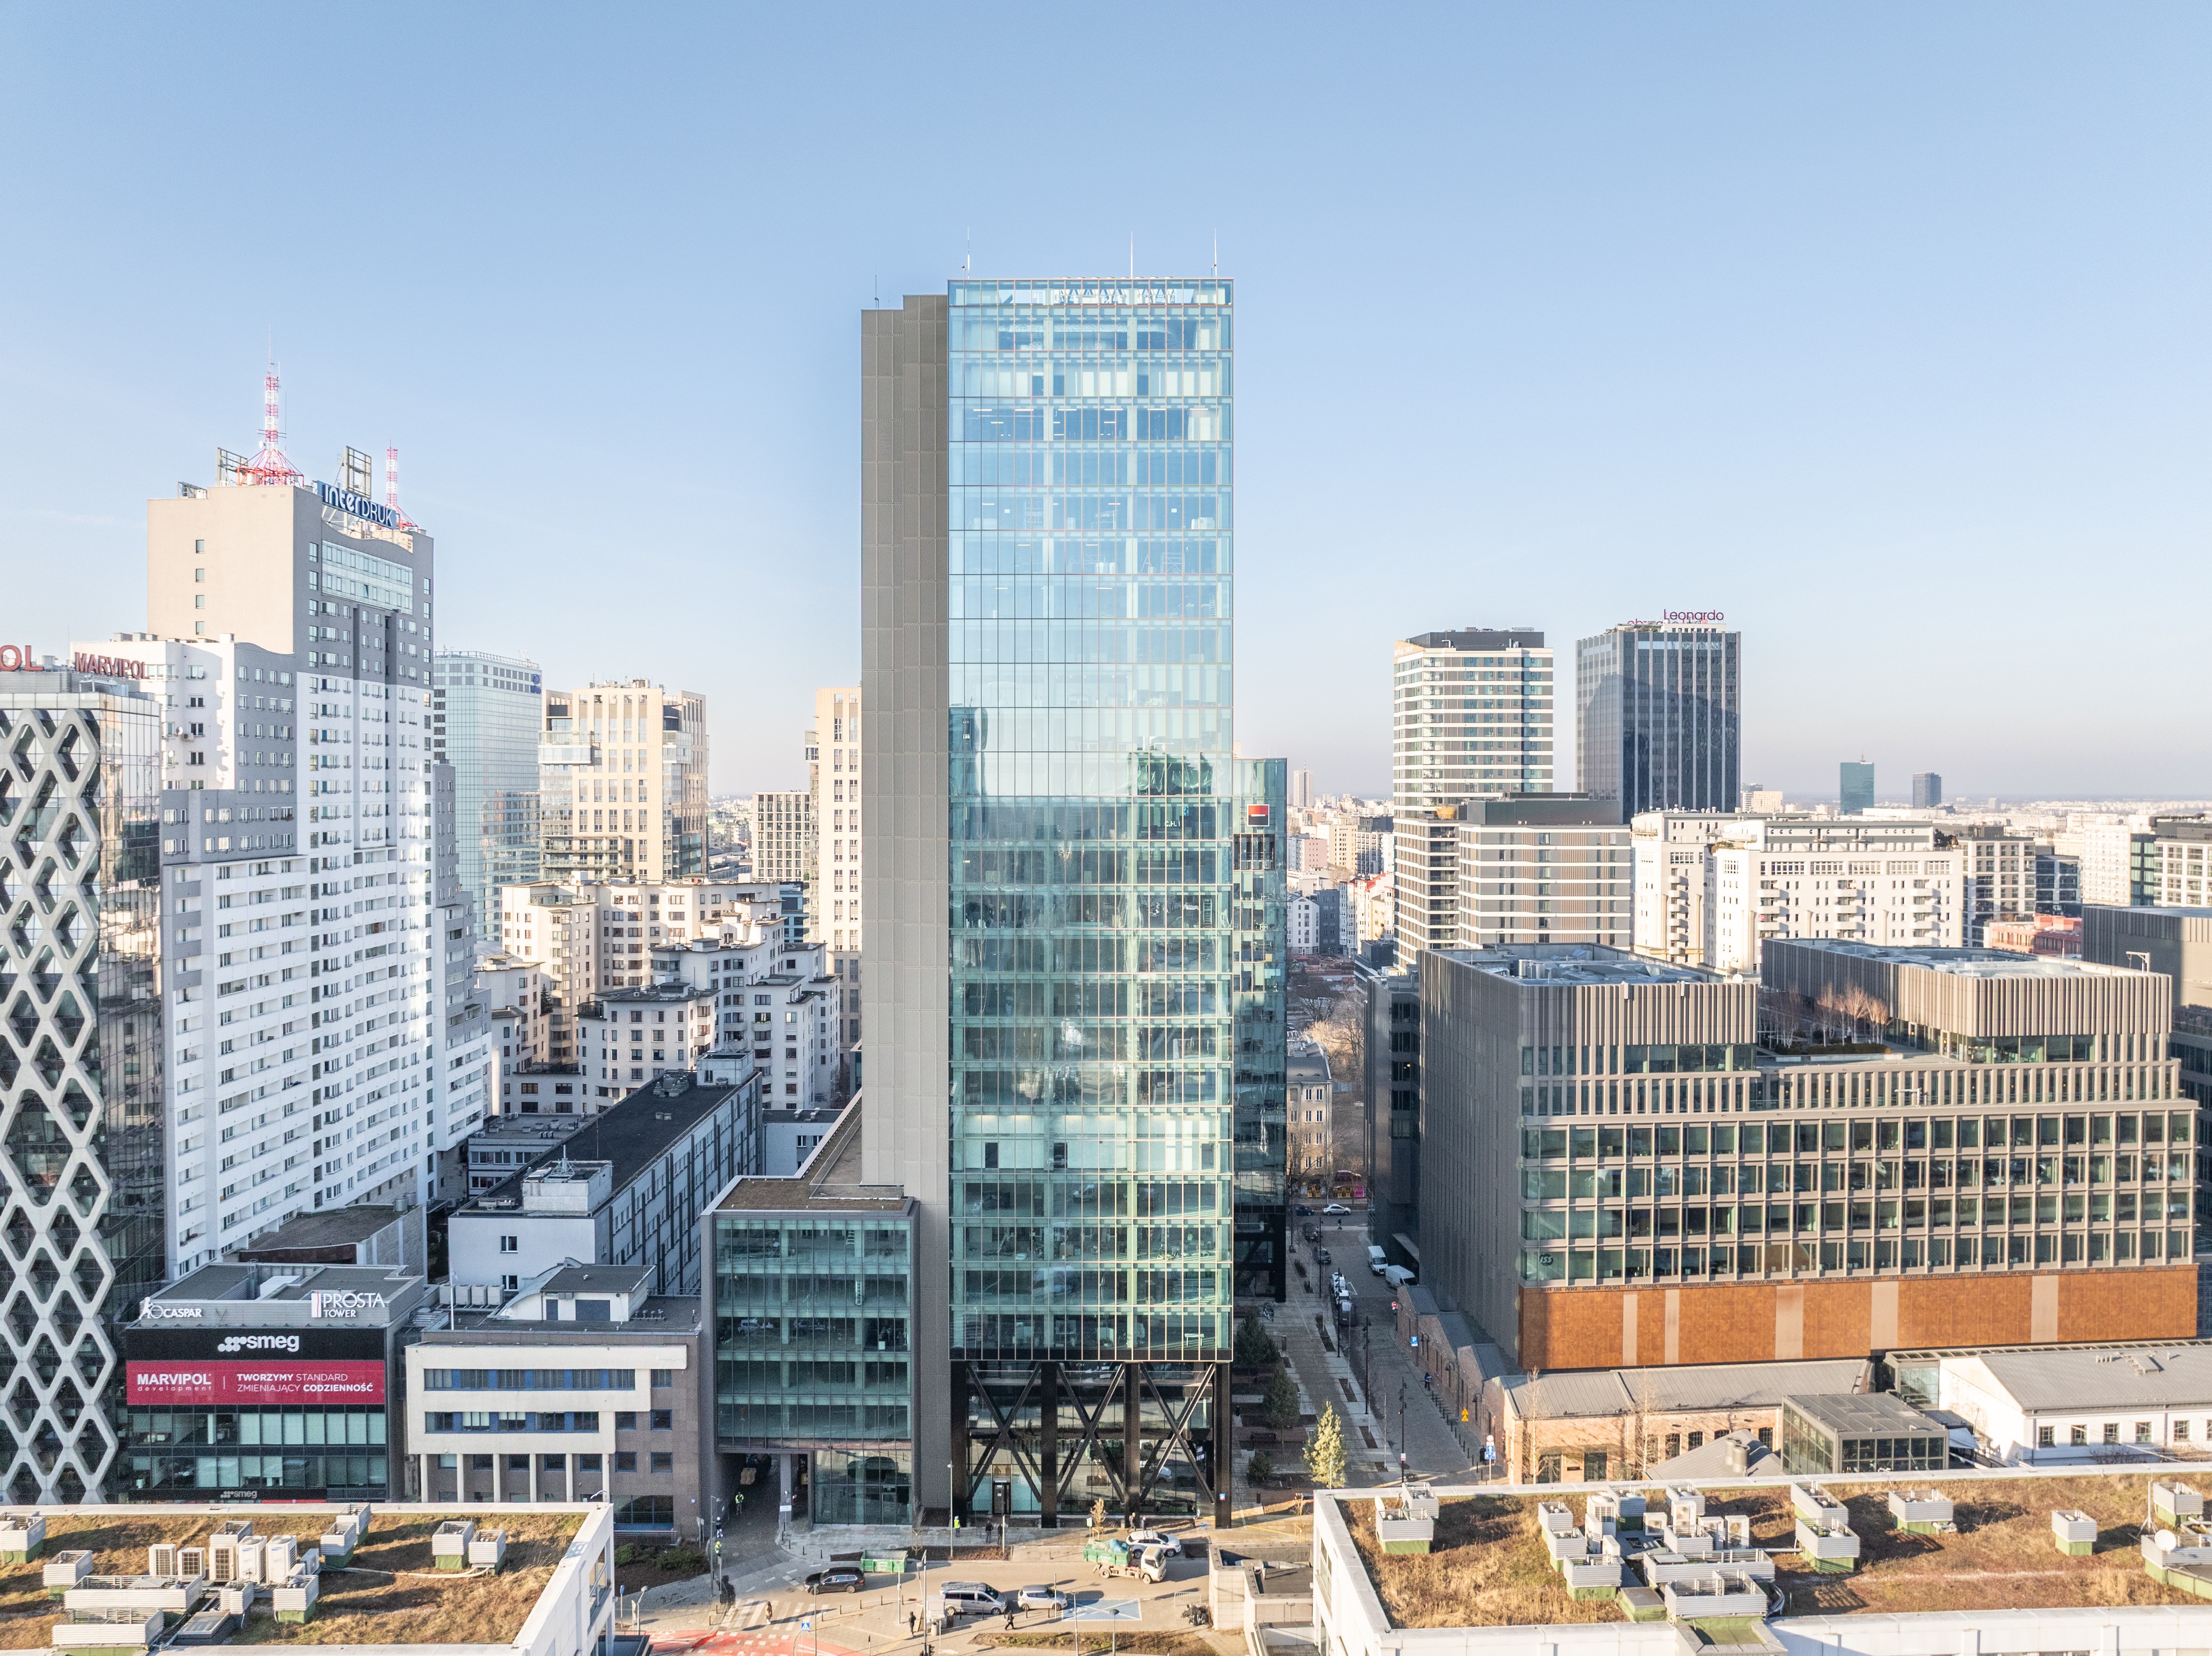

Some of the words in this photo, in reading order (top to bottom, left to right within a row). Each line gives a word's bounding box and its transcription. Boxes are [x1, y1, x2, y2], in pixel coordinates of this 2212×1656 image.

[1664, 609, 1724, 620] Leonardo
[74, 651, 150, 680] MARVIPOL
[323, 1292, 385, 1308] PROSTA
[163, 1308, 202, 1318] CASPAR
[323, 1309, 357, 1318] TOWER
[247, 1335, 300, 1352] smeg
[137, 1373, 211, 1385] MARVIPOL
[237, 1373, 294, 1381] TWORZYMY
[296, 1373, 348, 1381] STANDARD
[237, 1384, 301, 1393] ZMIENIAJĄCY
[303, 1383, 373, 1392] CODZIENNOŚĆ
[233, 1491, 257, 1499] smeg
